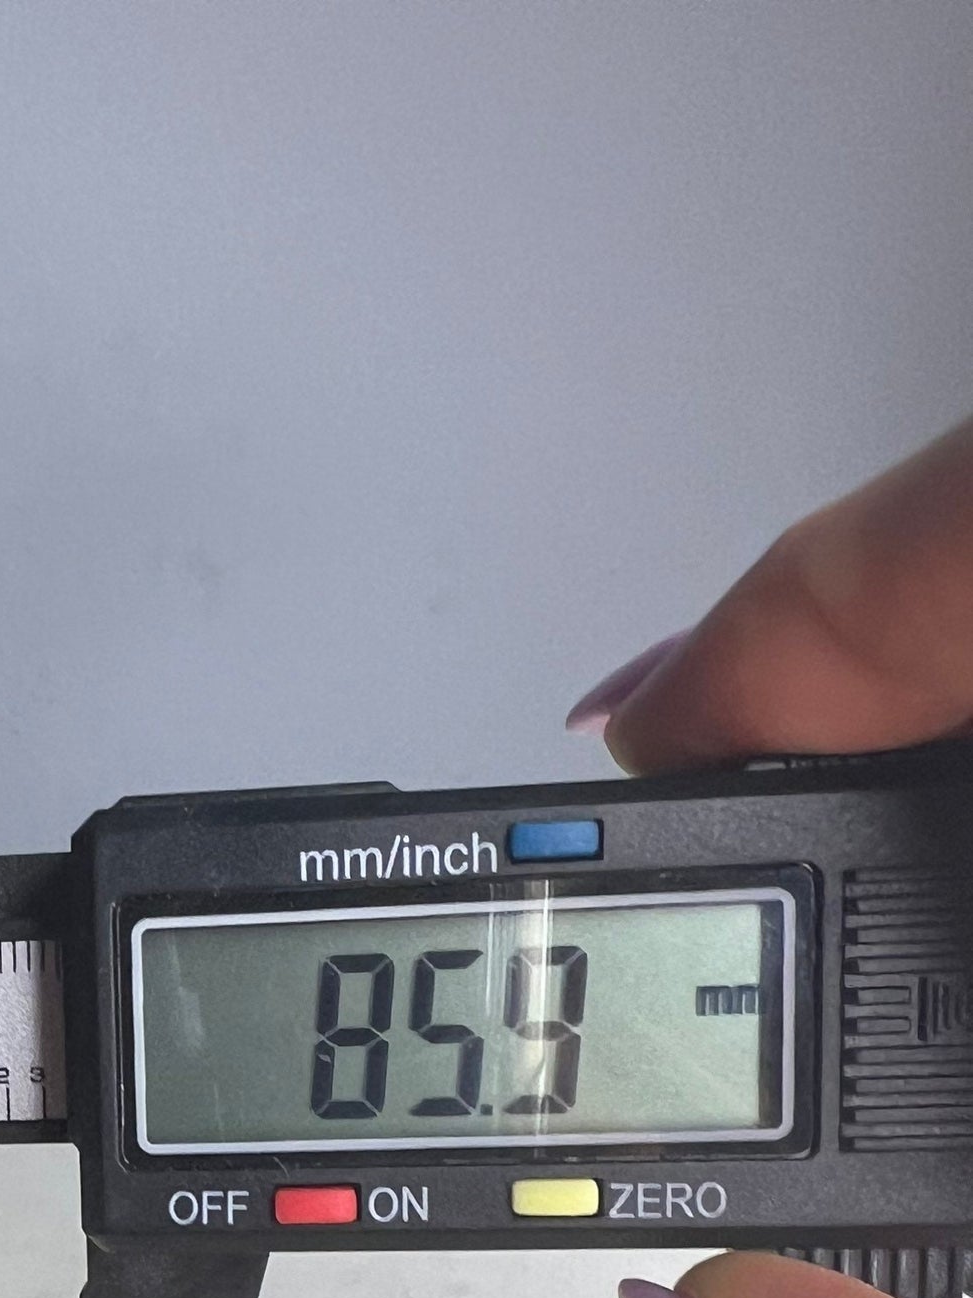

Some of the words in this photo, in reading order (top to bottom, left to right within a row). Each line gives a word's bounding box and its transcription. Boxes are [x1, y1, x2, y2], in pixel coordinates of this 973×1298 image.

[299, 831, 498, 882] mm/inch
[695, 985, 761, 1017] mm
[311, 944, 588, 1119] 85.9
[30, 1067, 45, 1083] 3
[169, 1189, 249, 1226] OFF
[368, 1186, 428, 1223] ON
[609, 1181, 728, 1221] ZERO
